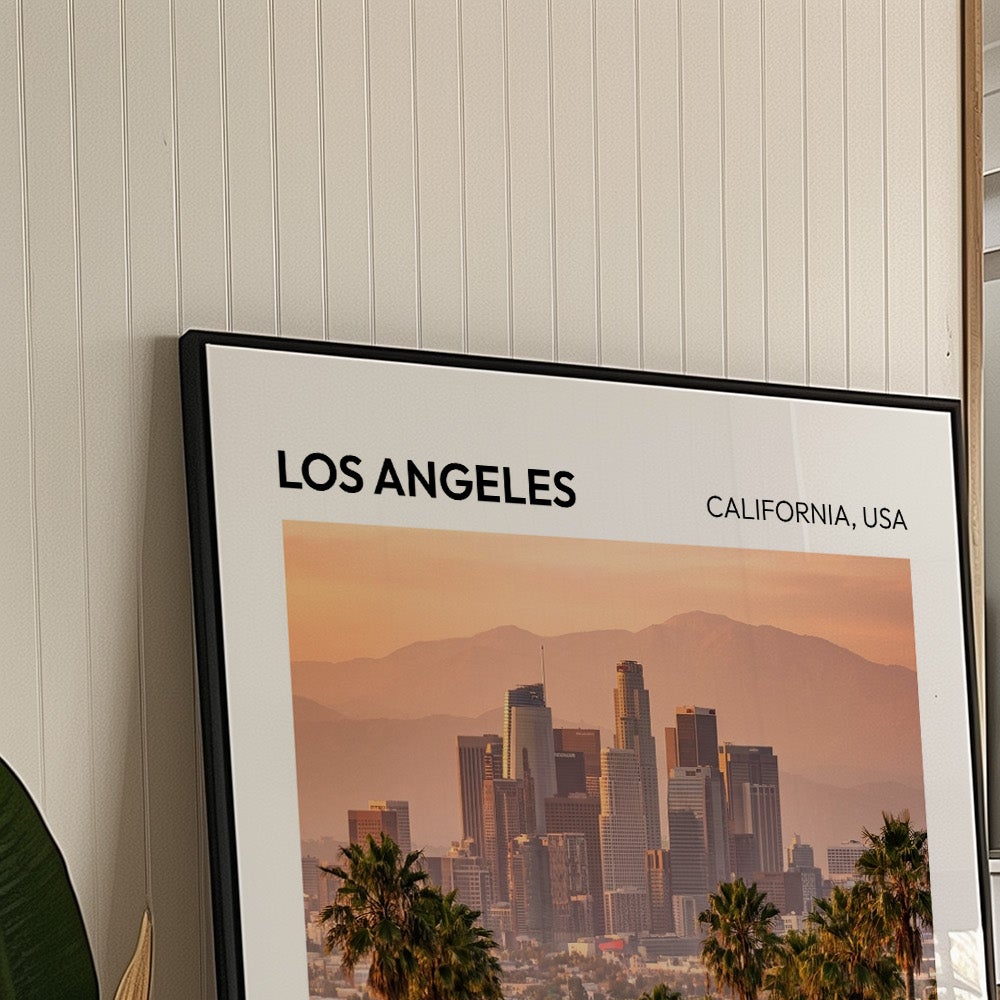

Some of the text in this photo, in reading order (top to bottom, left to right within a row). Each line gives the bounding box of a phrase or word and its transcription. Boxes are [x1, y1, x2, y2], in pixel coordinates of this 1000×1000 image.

[277, 449, 577, 509] LOS ANGELES
[706, 495, 908, 531] CALIFORNIA, USA
